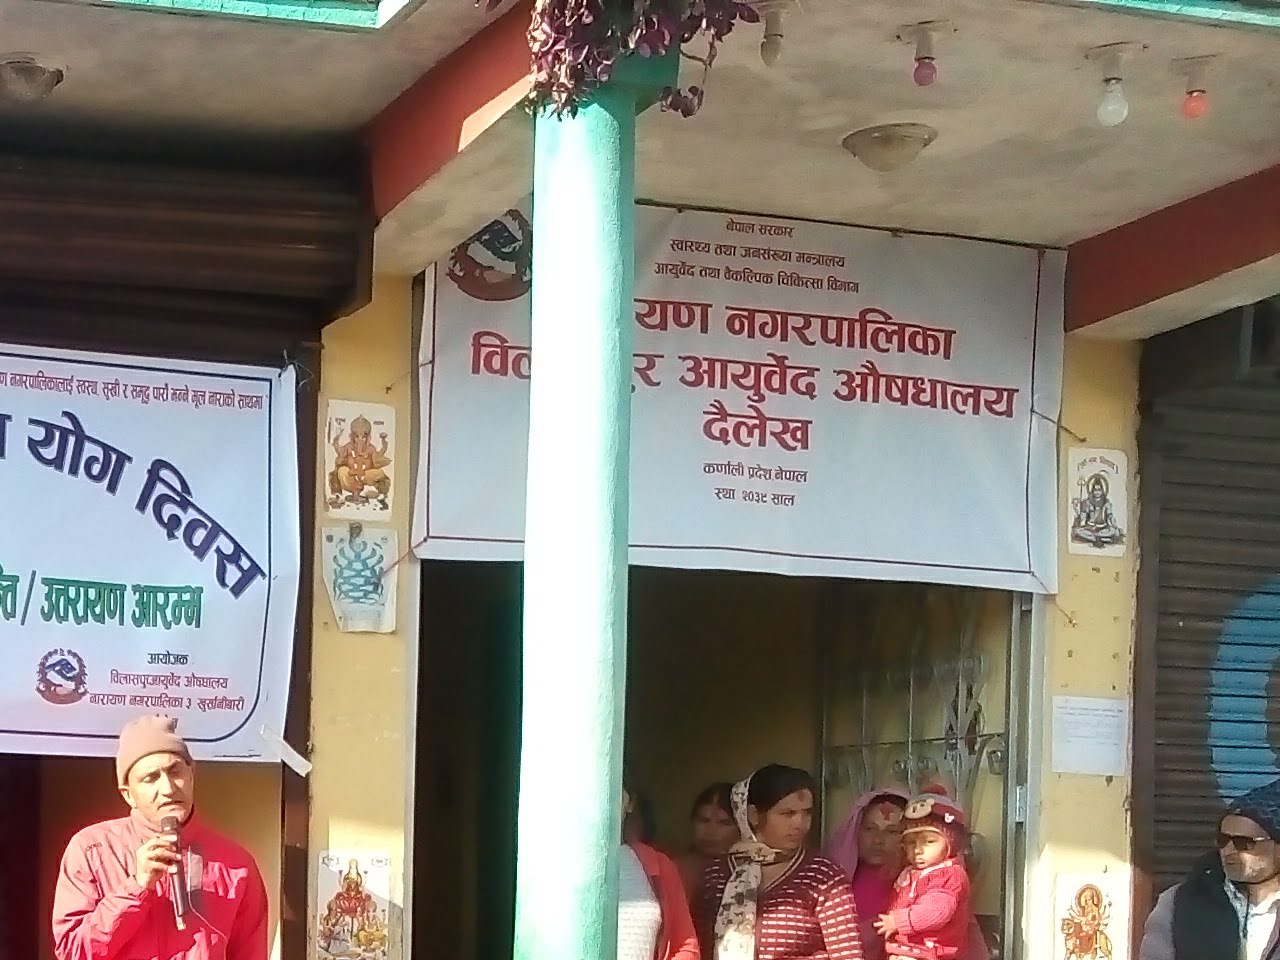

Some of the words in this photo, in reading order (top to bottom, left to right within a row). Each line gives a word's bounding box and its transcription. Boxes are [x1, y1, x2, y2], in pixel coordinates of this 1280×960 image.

[726, 218, 755, 234] नेपाल
[758, 222, 795, 238] सरकार
[714, 243, 736, 257] तथा
[740, 245, 792, 262] जनसंख्या
[795, 250, 845, 268] मन्त्रालय
[699, 265, 721, 279] तथा
[777, 270, 823, 290] चिकित्सा
[725, 307, 957, 360] नगरपालिका
[122, 383, 129, 399] र
[678, 352, 821, 403] आयुर्वेद
[832, 360, 1020, 419] औषधालय
[702, 400, 813, 452] दैलेख
[703, 461, 744, 476] कर्णाली
[28, 410, 134, 496] योग
[135, 458, 267, 599] दिवस
[771, 493, 796, 506] साल
[40, 577, 126, 626] उत्तरायण
